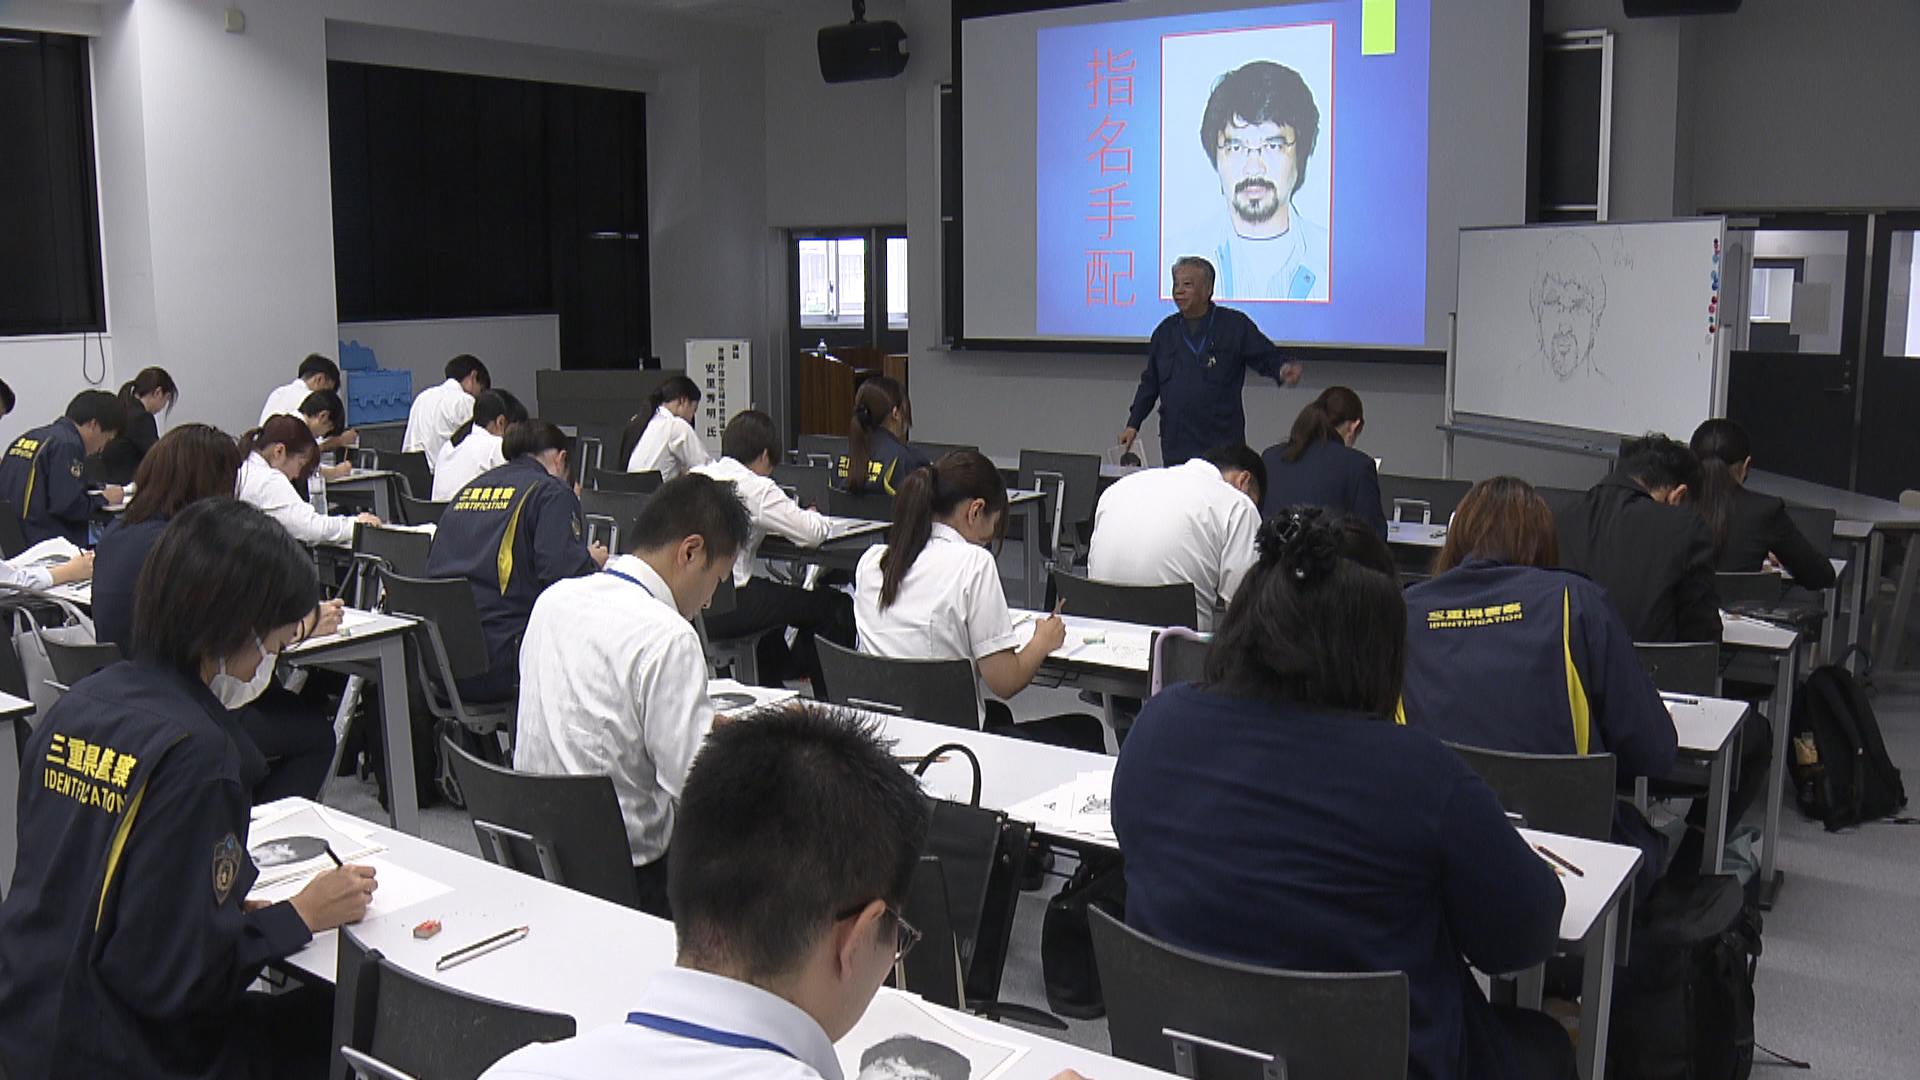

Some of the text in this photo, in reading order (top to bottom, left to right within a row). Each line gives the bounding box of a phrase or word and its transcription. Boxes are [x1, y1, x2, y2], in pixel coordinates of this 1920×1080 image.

[1085, 48, 1136, 306] 指名手配
[46, 733, 137, 790] 三重県警察
